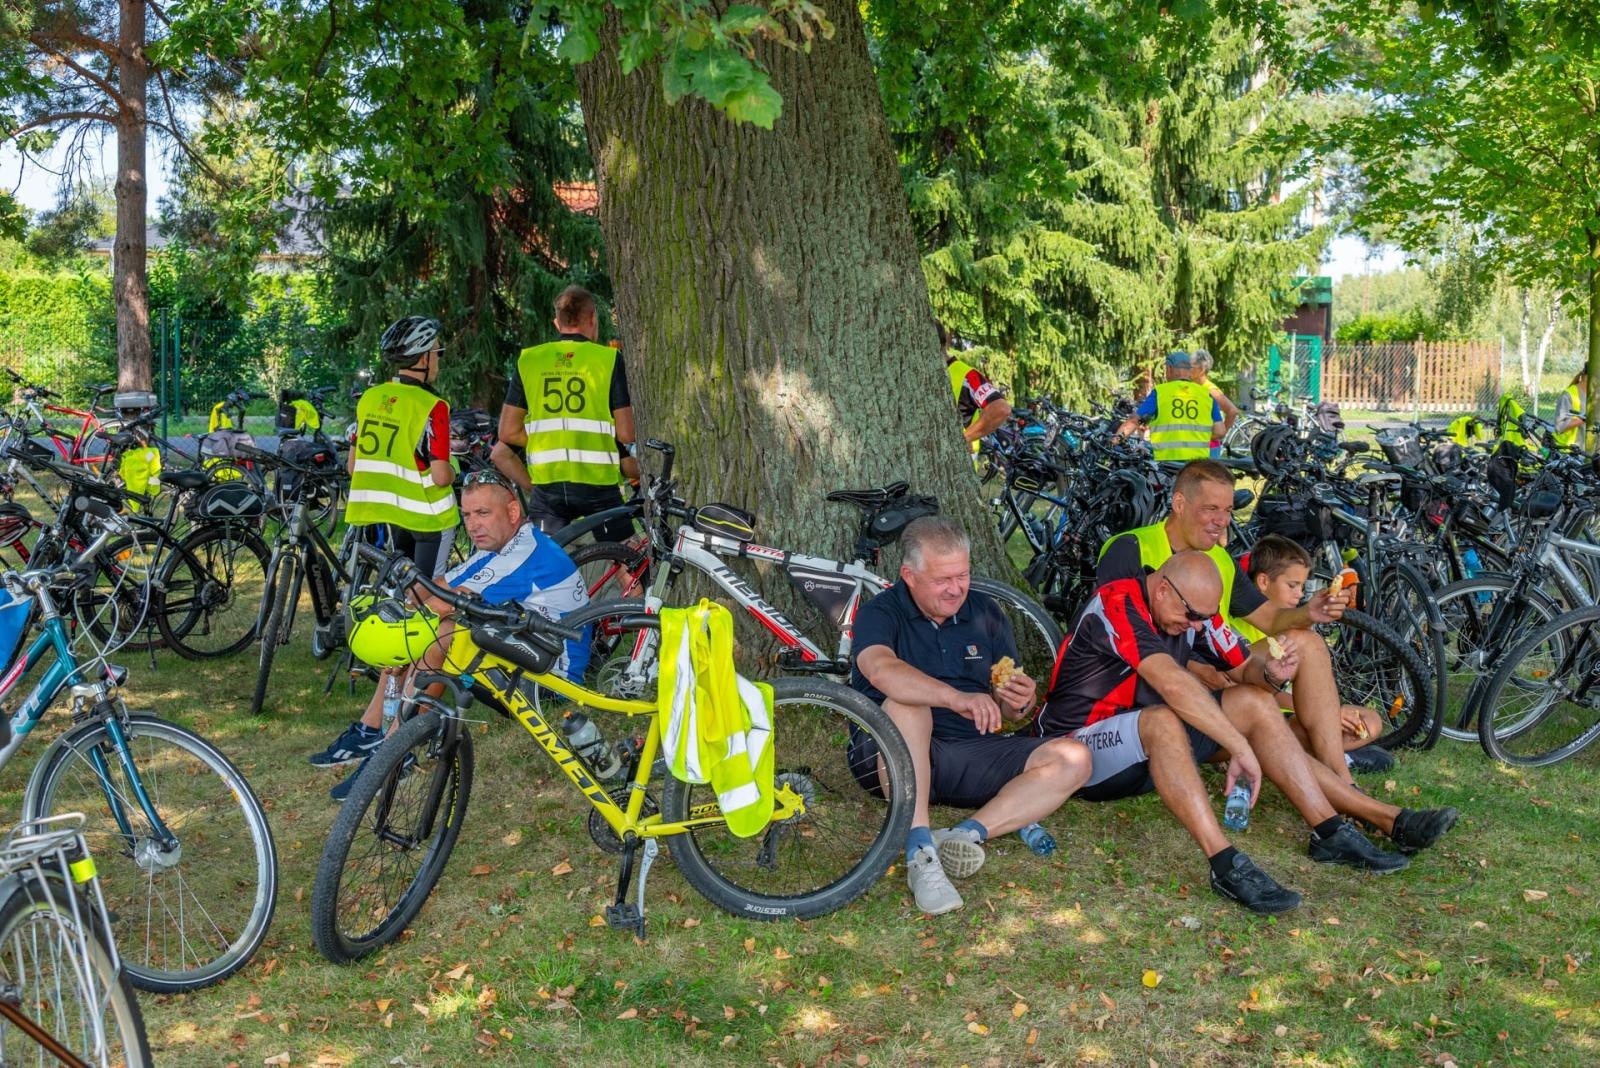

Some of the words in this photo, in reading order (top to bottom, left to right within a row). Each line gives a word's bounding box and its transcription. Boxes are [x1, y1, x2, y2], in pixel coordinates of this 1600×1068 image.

[543, 376, 586, 414] 58
[1171, 398, 1199, 420] 86
[358, 419, 400, 458] 57
[311, 563, 329, 618] UNIBIKE
[713, 565, 802, 639] MERIDA
[508, 688, 612, 805] ROMET
